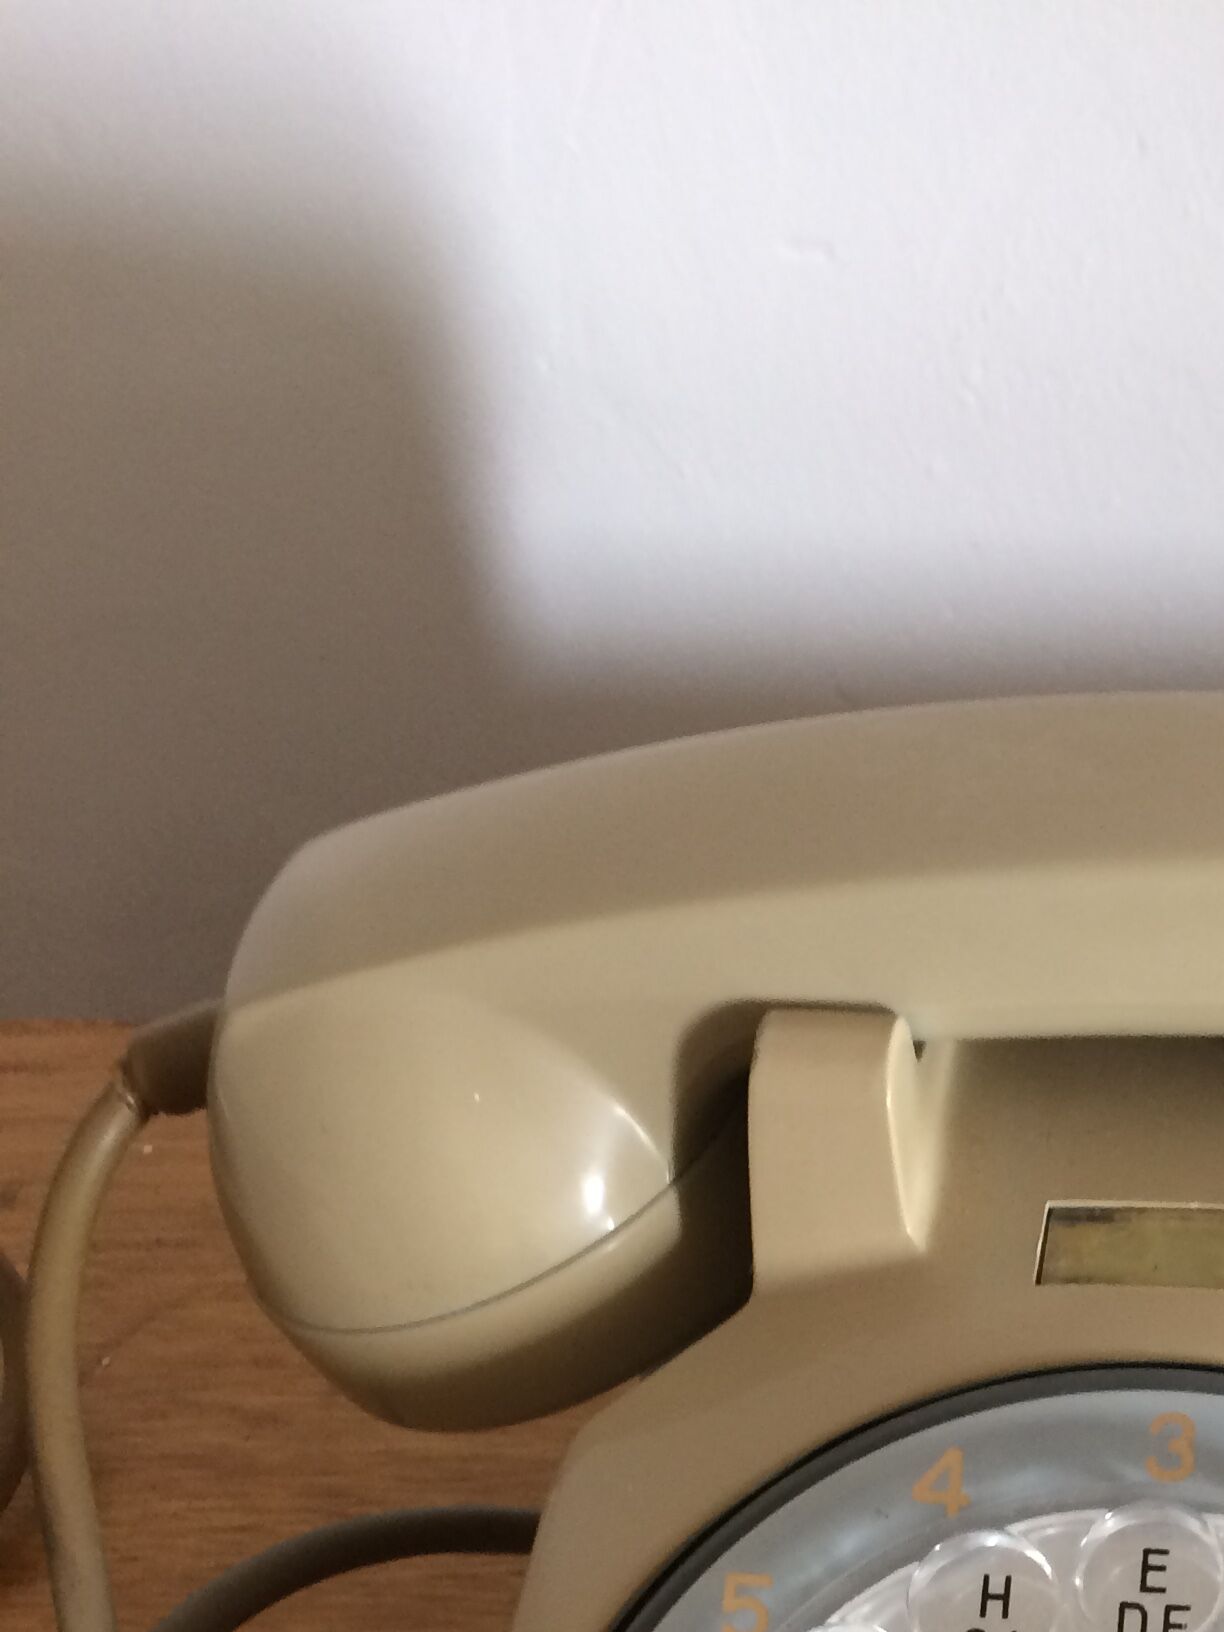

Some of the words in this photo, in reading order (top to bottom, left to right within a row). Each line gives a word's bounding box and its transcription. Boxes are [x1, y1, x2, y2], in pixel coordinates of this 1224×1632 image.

[1147, 1413, 1195, 1480] 3
[913, 1448, 970, 1517] 4
[978, 1574, 1012, 1619] H
[1139, 1548, 1171, 1594] E
